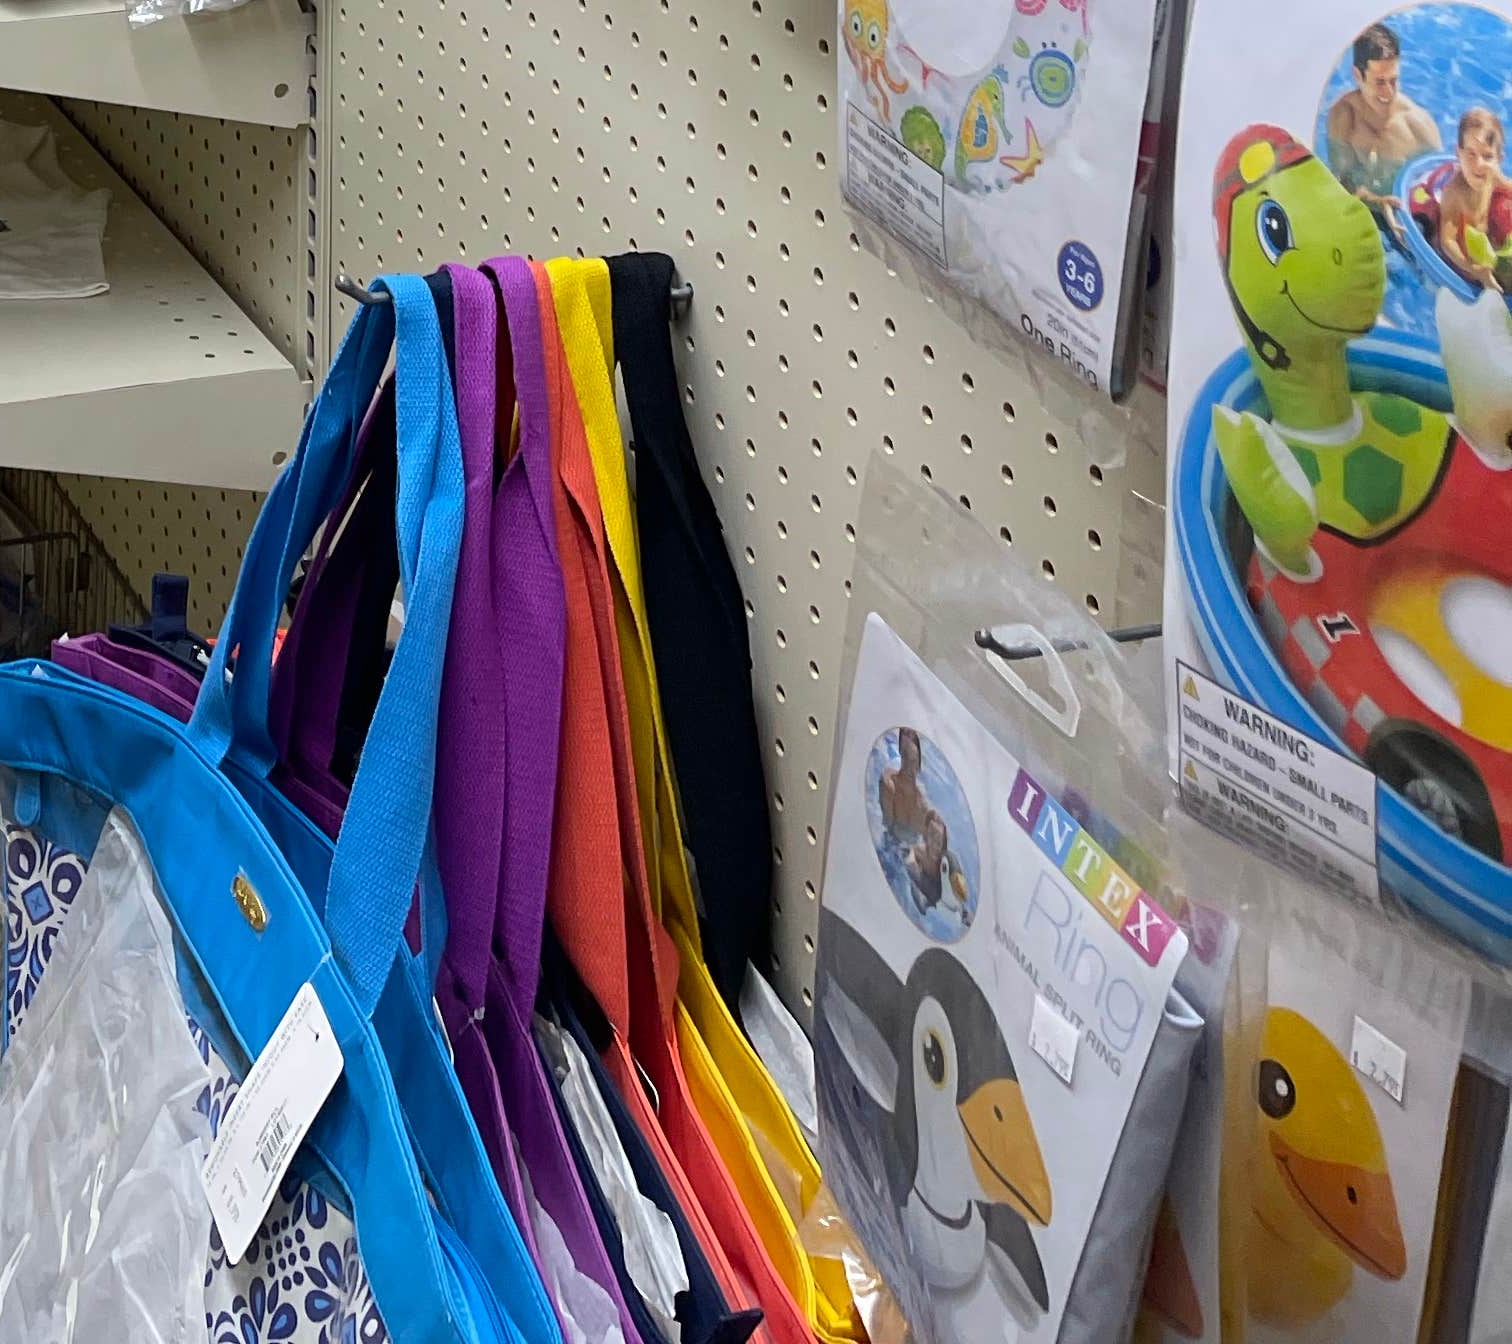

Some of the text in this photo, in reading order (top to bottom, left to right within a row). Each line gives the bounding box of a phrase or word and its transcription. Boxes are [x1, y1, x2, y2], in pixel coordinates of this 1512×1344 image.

[1064, 259, 1096, 294] 3-6
[1021, 313, 1099, 392] One Ring
[1183, 703, 1229, 745] CHOKING
[1231, 730, 1276, 772] HAZARD
[1288, 766, 1327, 803] SMALL
[1330, 789, 1369, 826] PARTS
[1202, 741, 1221, 764] FOR
[1222, 752, 1271, 795] CHILDREN
[1272, 787, 1306, 817] UNDER
[1223, 696, 1316, 767] WARNING:
[1016, 782, 1162, 954] INTEX
[993, 922, 1122, 1079] ANIMAL SPLIT RING
[1024, 869, 1144, 1053] Ring
